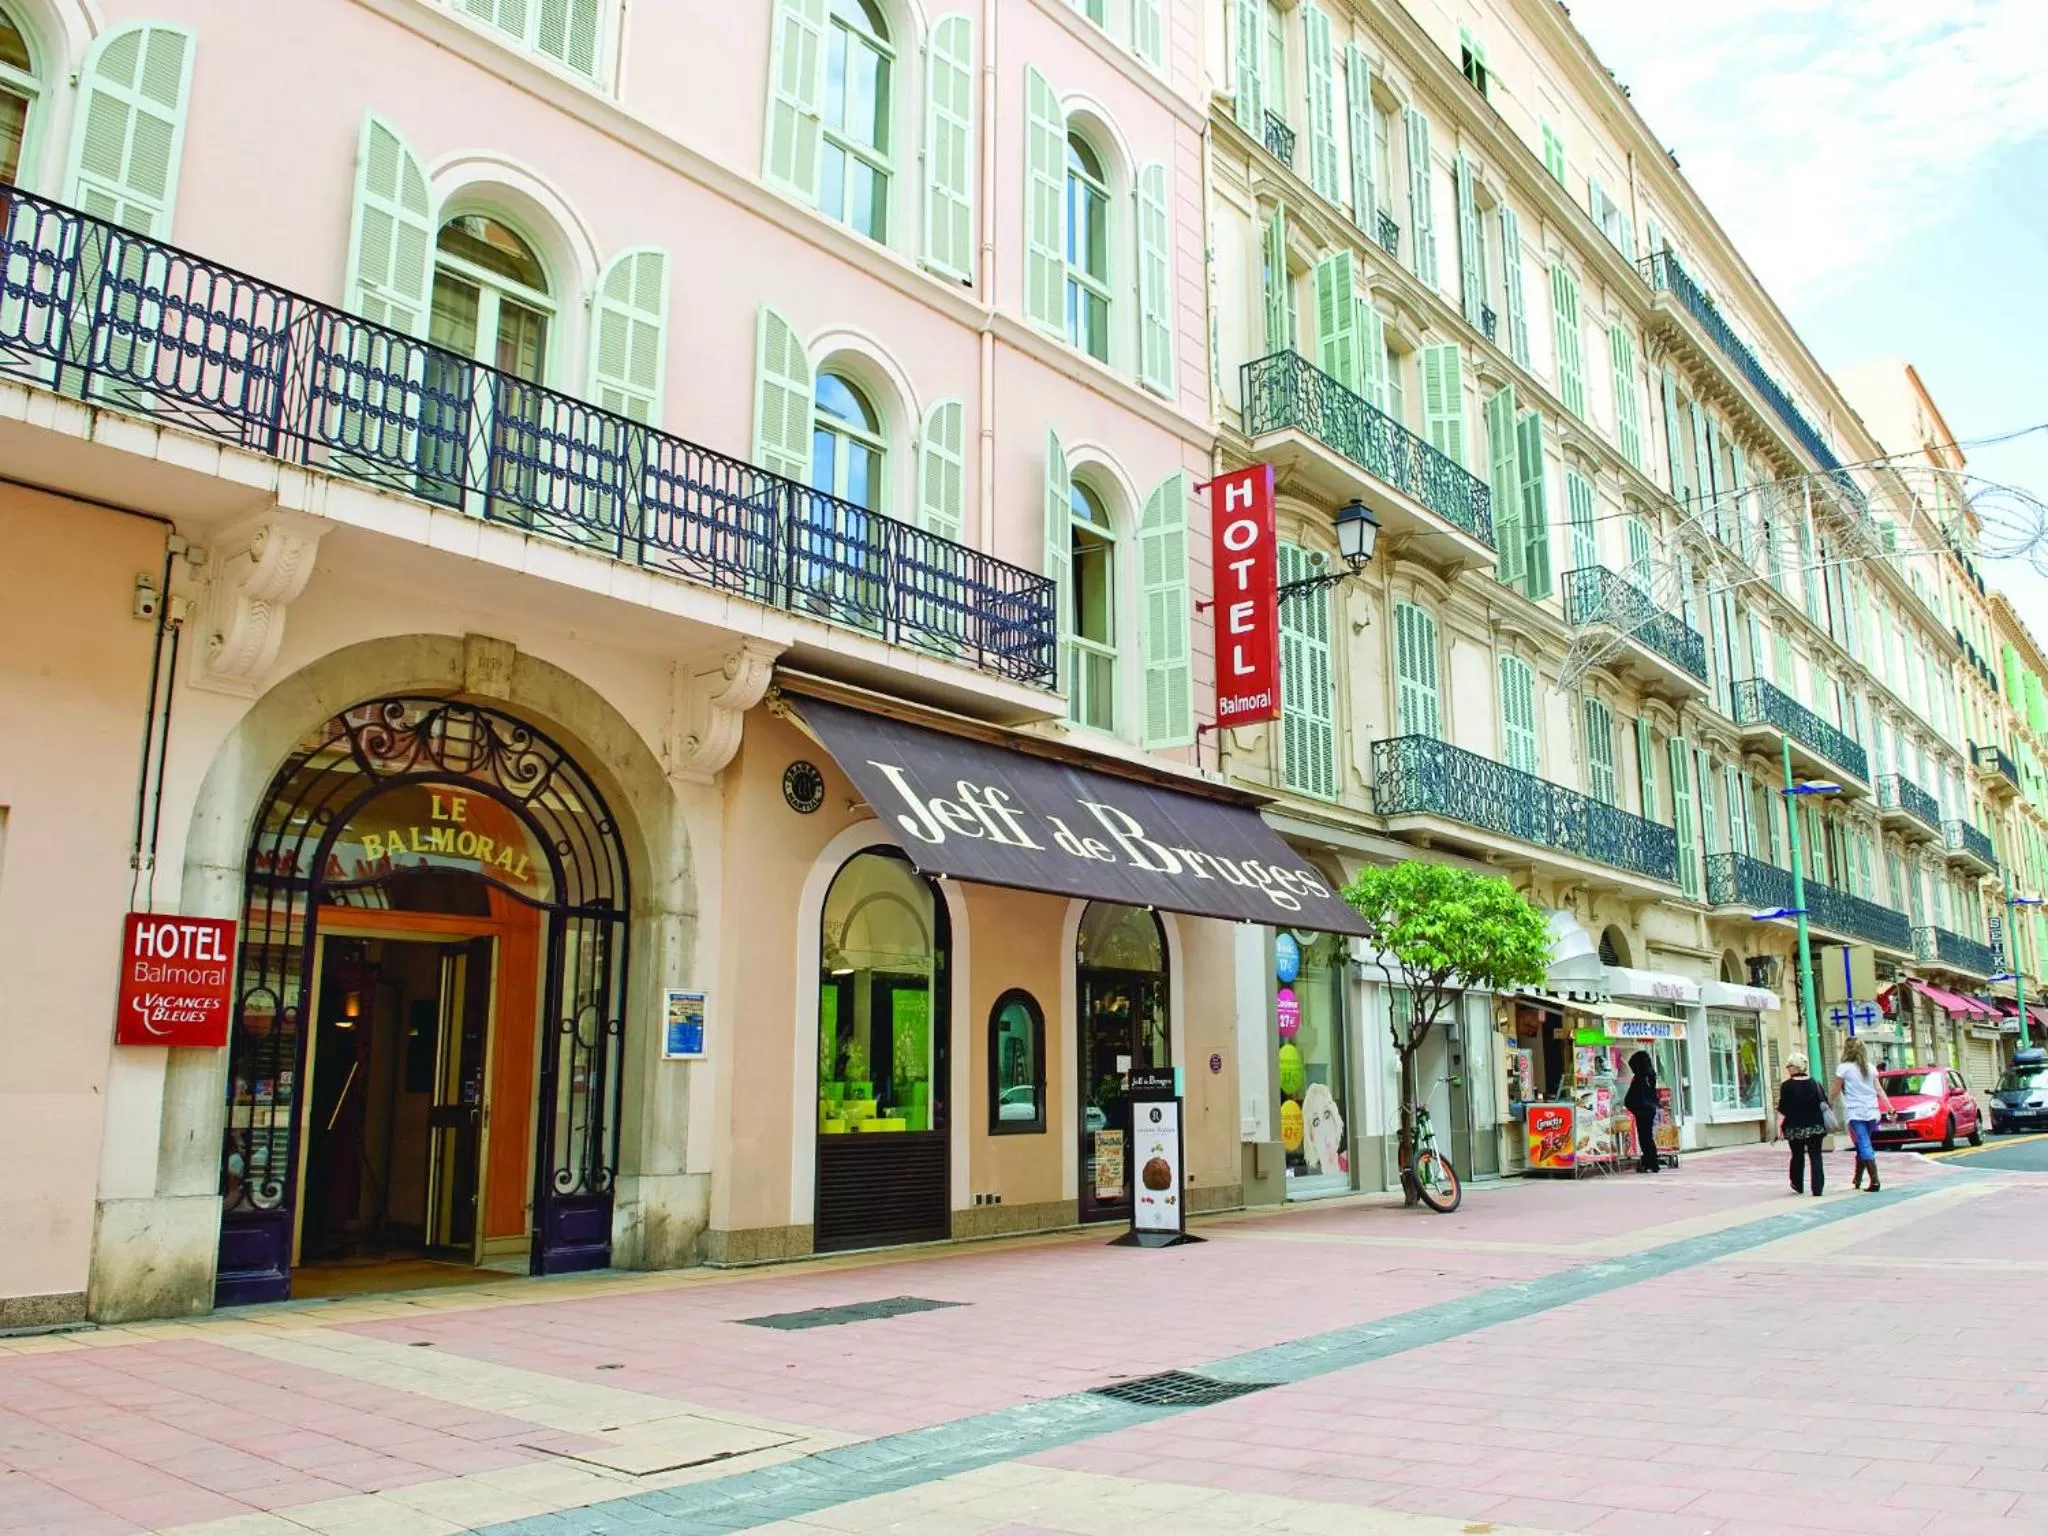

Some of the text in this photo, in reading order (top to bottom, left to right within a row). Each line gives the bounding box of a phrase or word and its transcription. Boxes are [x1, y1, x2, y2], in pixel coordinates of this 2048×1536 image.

[1222, 478, 1259, 676] HOTEL
[1219, 688, 1271, 716] Balmoral
[431, 795, 467, 822] LE
[866, 760, 1046, 850] Jeff
[361, 827, 532, 882] BALMORAL
[1046, 815, 1116, 863] de
[1077, 799, 1330, 911] Bruges
[134, 922, 227, 961] HOTEL
[134, 962, 226, 985] Balmoral
